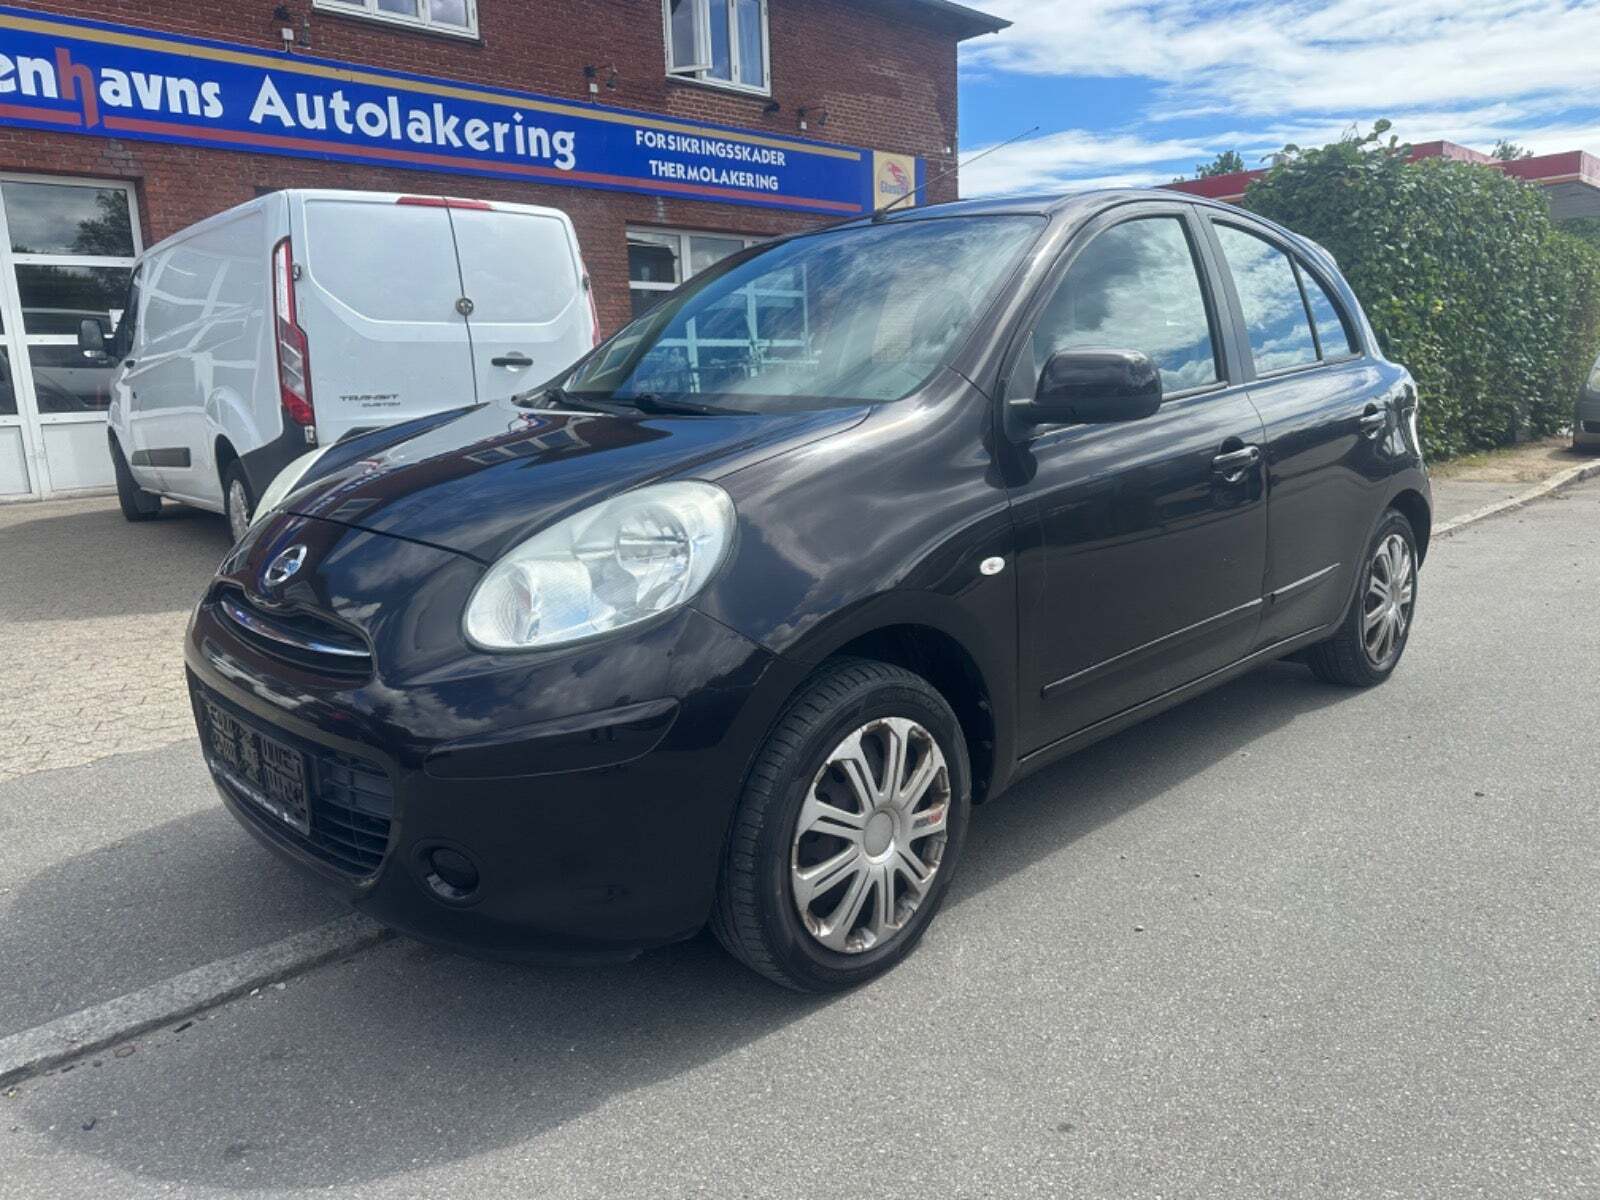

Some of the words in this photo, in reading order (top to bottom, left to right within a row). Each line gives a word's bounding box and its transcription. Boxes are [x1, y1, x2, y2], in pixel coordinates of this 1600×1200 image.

[249, 74, 576, 170] Autolakering
[635, 130, 786, 167] FORSIKRINGSSKADER
[649, 159, 779, 191] THERMOLAKERING
